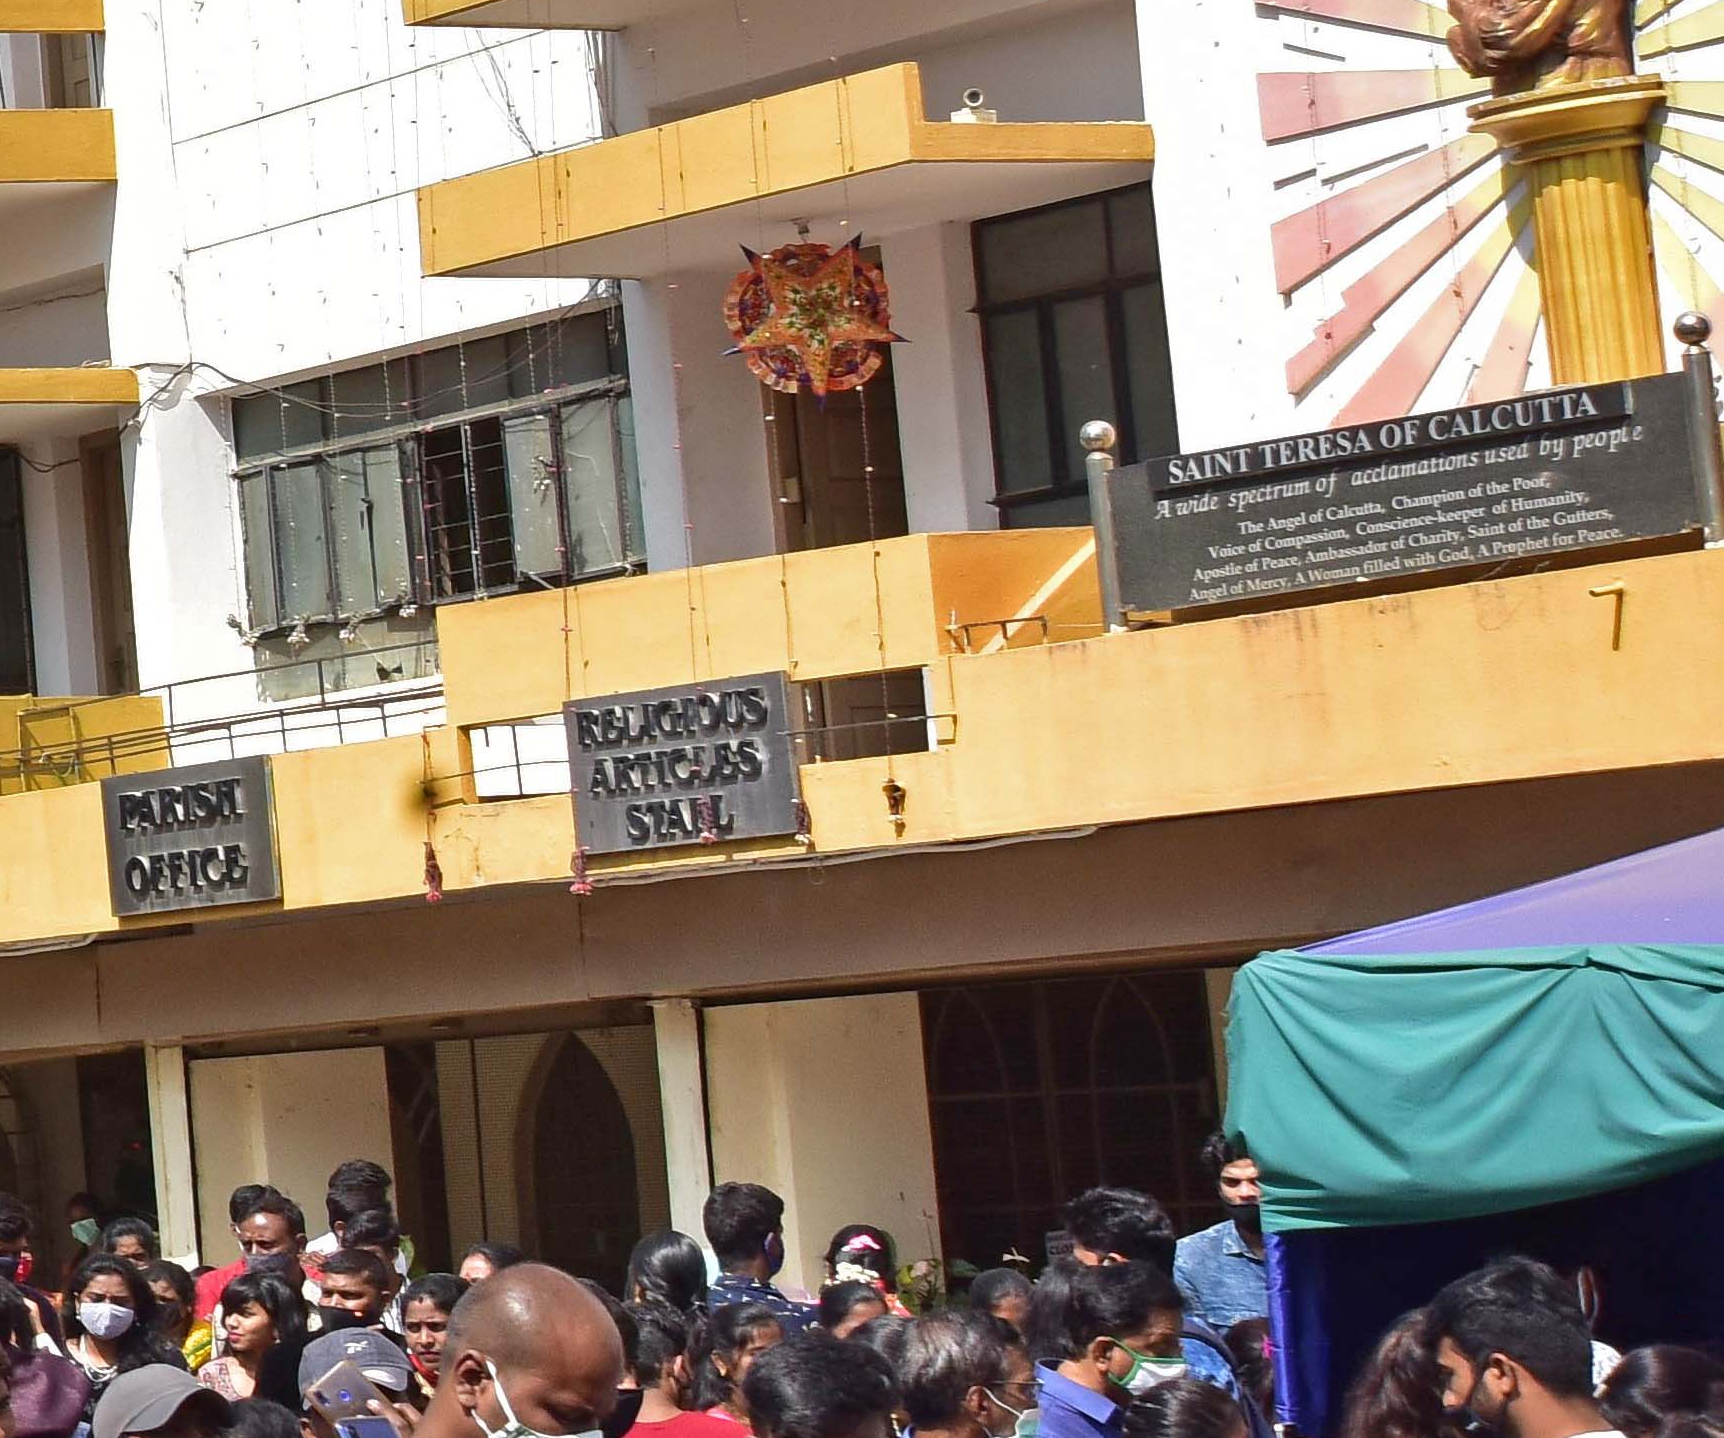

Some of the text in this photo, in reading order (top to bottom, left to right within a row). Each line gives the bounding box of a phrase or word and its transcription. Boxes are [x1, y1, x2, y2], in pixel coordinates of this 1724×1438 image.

[1168, 392, 1597, 484] SAINT TERESA OF CALCUTTA
[1154, 424, 1644, 519] A wide spectrum of acclamations used by people
[1207, 490, 1590, 560] Voice of Compassion, Conscience-keeper of Humanity,
[1238, 475, 1551, 535] The Angel of Calcutta, Champion of the Poor,
[1189, 585, 1227, 602] Angel
[1230, 580, 1245, 595] of
[1294, 570, 1307, 585] A
[1307, 565, 1361, 584] Woman
[1362, 557, 1401, 576] filled
[1403, 552, 1436, 568] with
[1477, 544, 1490, 558] A
[1492, 537, 1550, 556] Prophet
[1552, 532, 1575, 547] for
[1193, 562, 1243, 582] Apostle
[1245, 558, 1260, 573] of
[1262, 554, 1302, 571] Peace,
[1305, 540, 1388, 564] Ambassador
[1391, 535, 1407, 551] of
[1408, 529, 1466, 547] Charity,
[1467, 522, 1506, 539] Saint
[1508, 518, 1525, 533] of
[1526, 514, 1550, 530] the
[575, 686, 767, 750] RELIGIOUS
[587, 738, 765, 799] ARTICLES
[116, 778, 246, 831] PARISH
[124, 841, 248, 903] OFFICE
